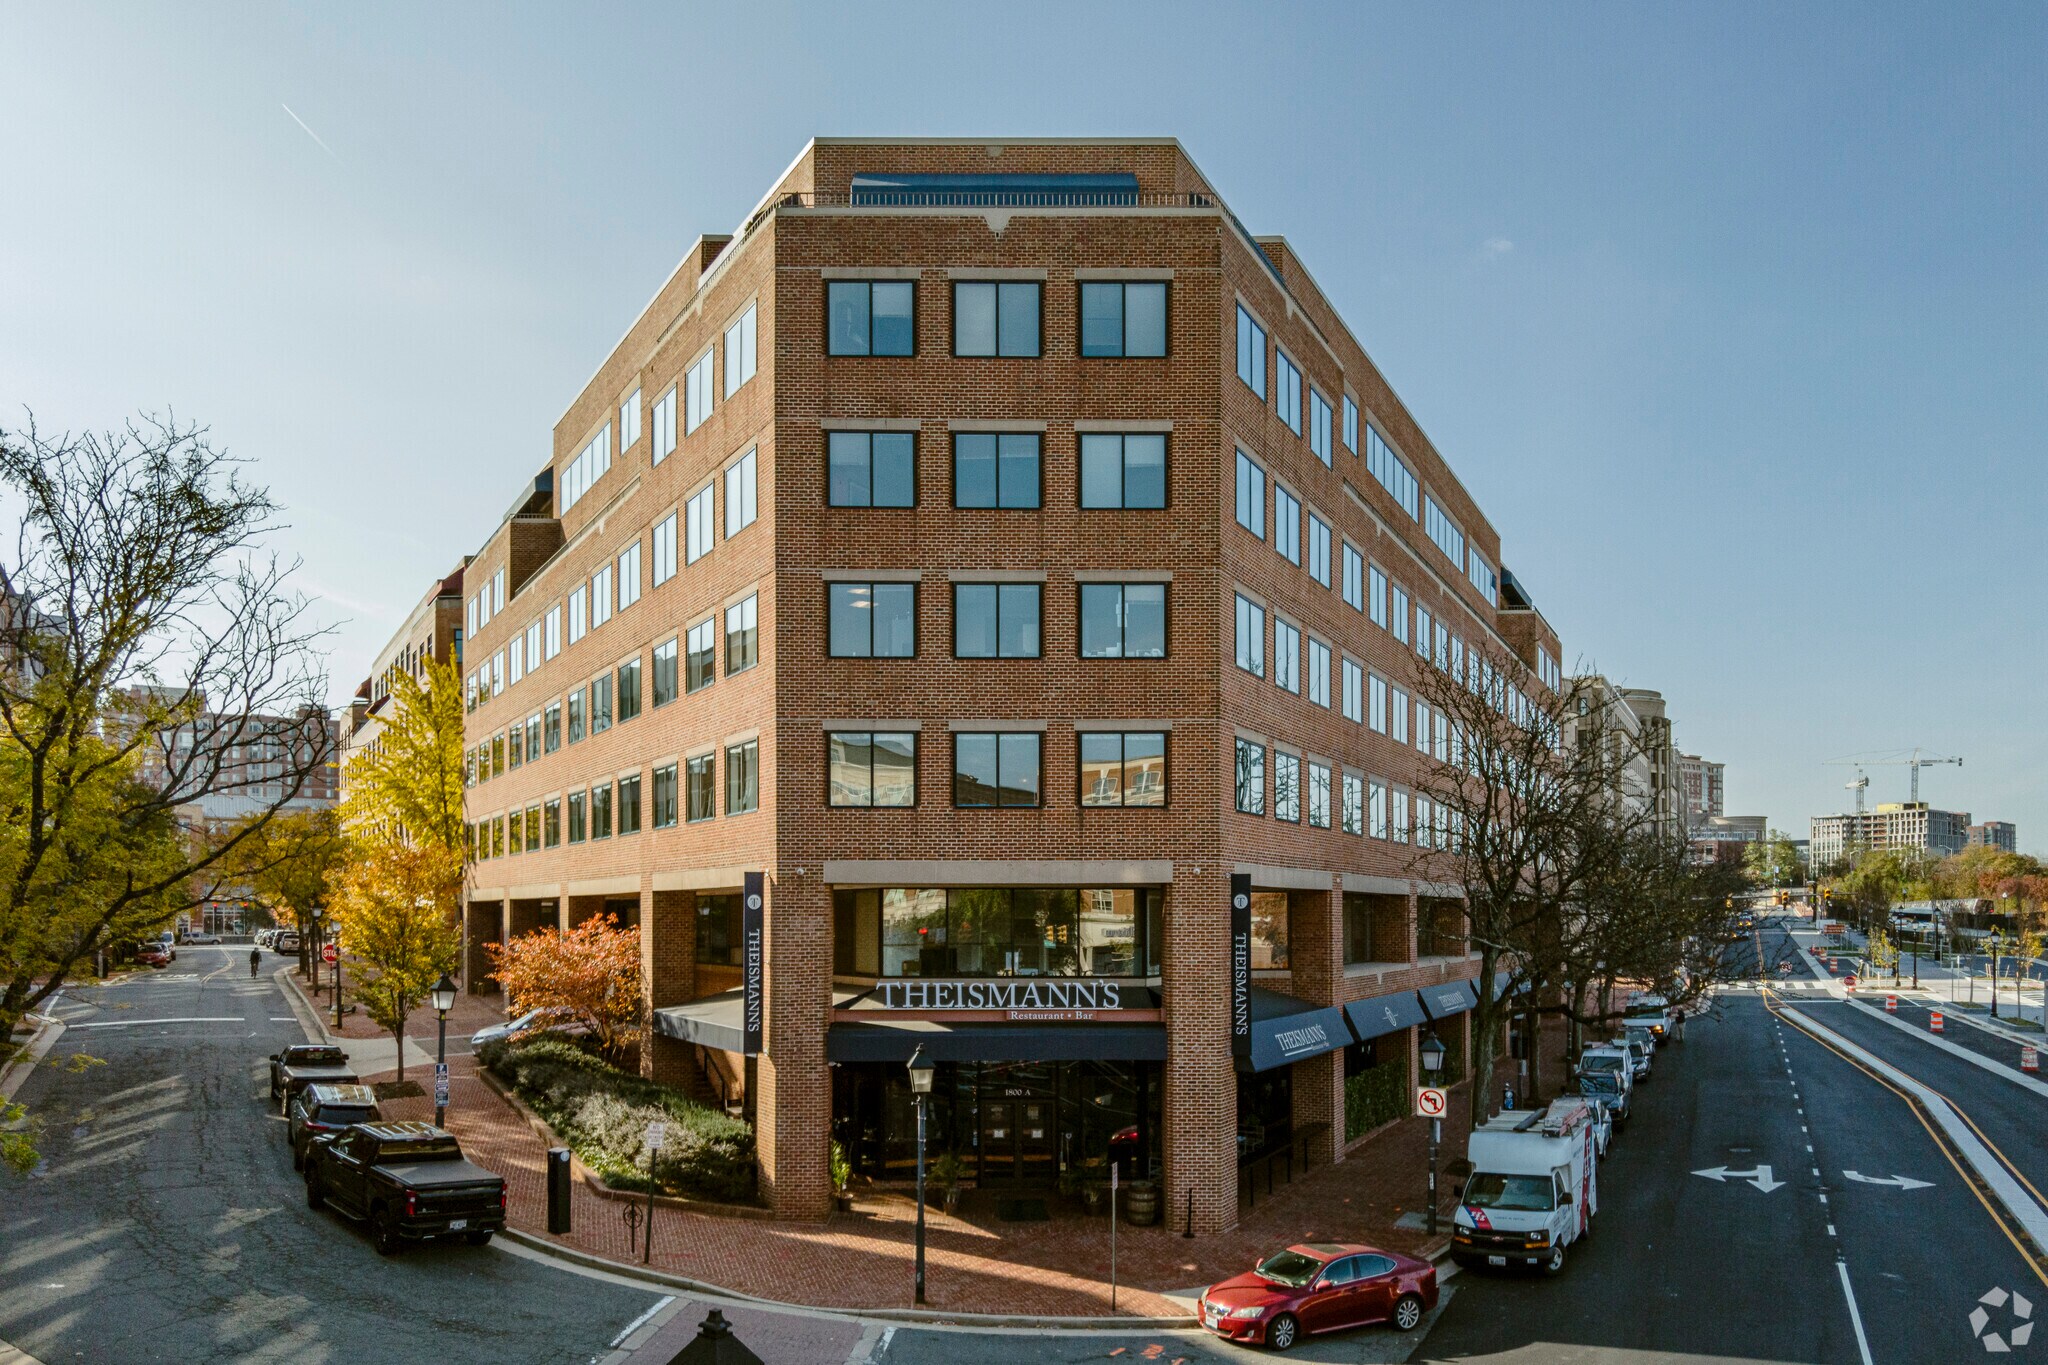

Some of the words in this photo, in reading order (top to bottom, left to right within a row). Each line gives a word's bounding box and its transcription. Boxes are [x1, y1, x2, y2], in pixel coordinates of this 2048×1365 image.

[323, 949, 337, 958] STO
[748, 929, 761, 1032] THEISMANN'S
[876, 979, 1120, 1009] THEISMANN'S
[1235, 933, 1249, 1035] THEISMANN'S
[1010, 1011, 1065, 1020] Restaurant
[1075, 1011, 1094, 1020] Bar
[1274, 1023, 1327, 1051] THEISMANN'S
